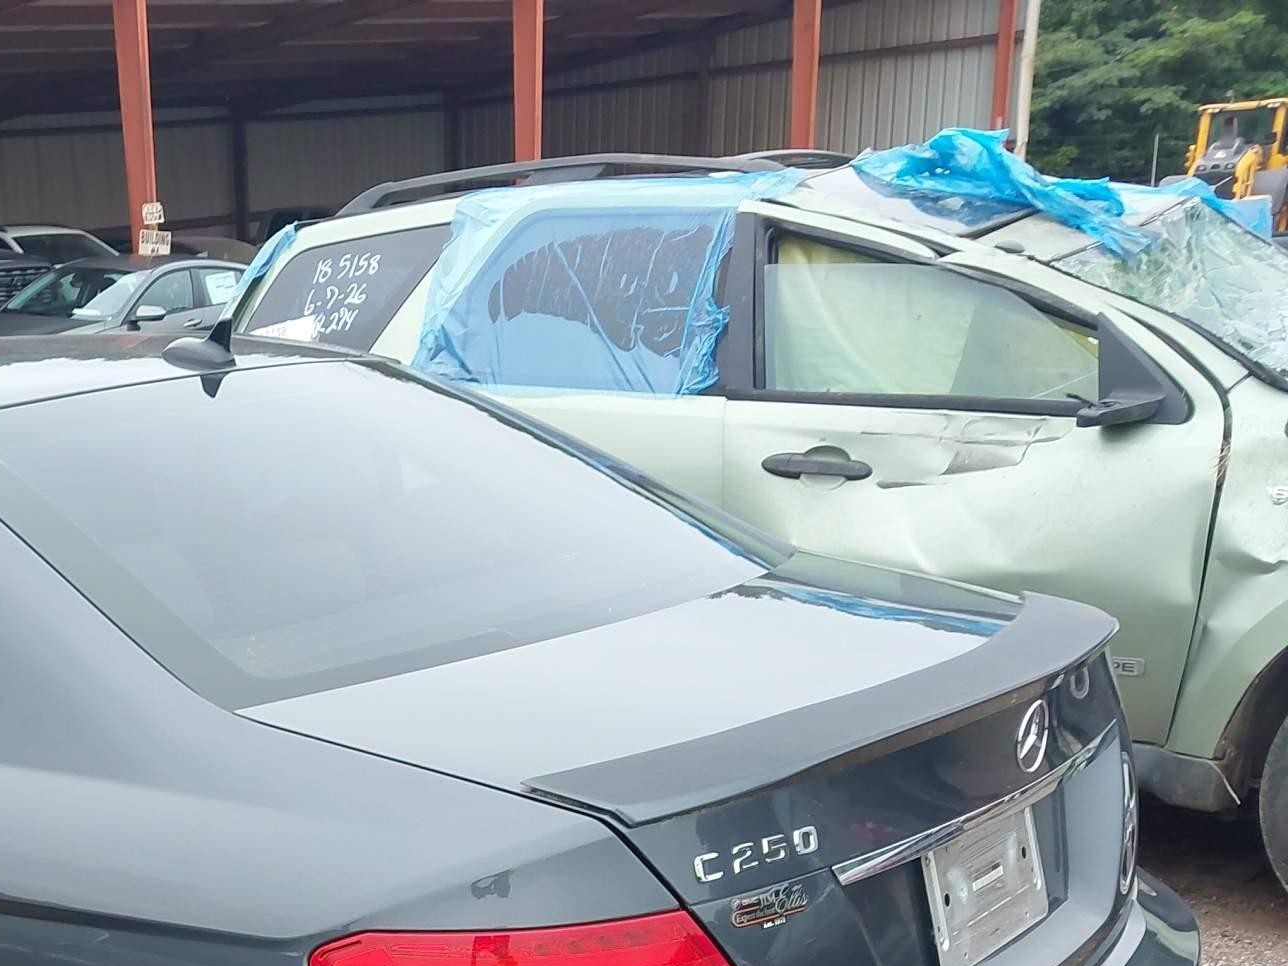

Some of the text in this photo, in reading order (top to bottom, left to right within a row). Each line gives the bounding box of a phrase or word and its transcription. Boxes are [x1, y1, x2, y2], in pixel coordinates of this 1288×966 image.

[141, 231, 169, 246] BUILDING
[312, 252, 381, 284] 18 5158
[694, 825, 819, 882] C 250
[775, 883, 809, 914] Ellis
